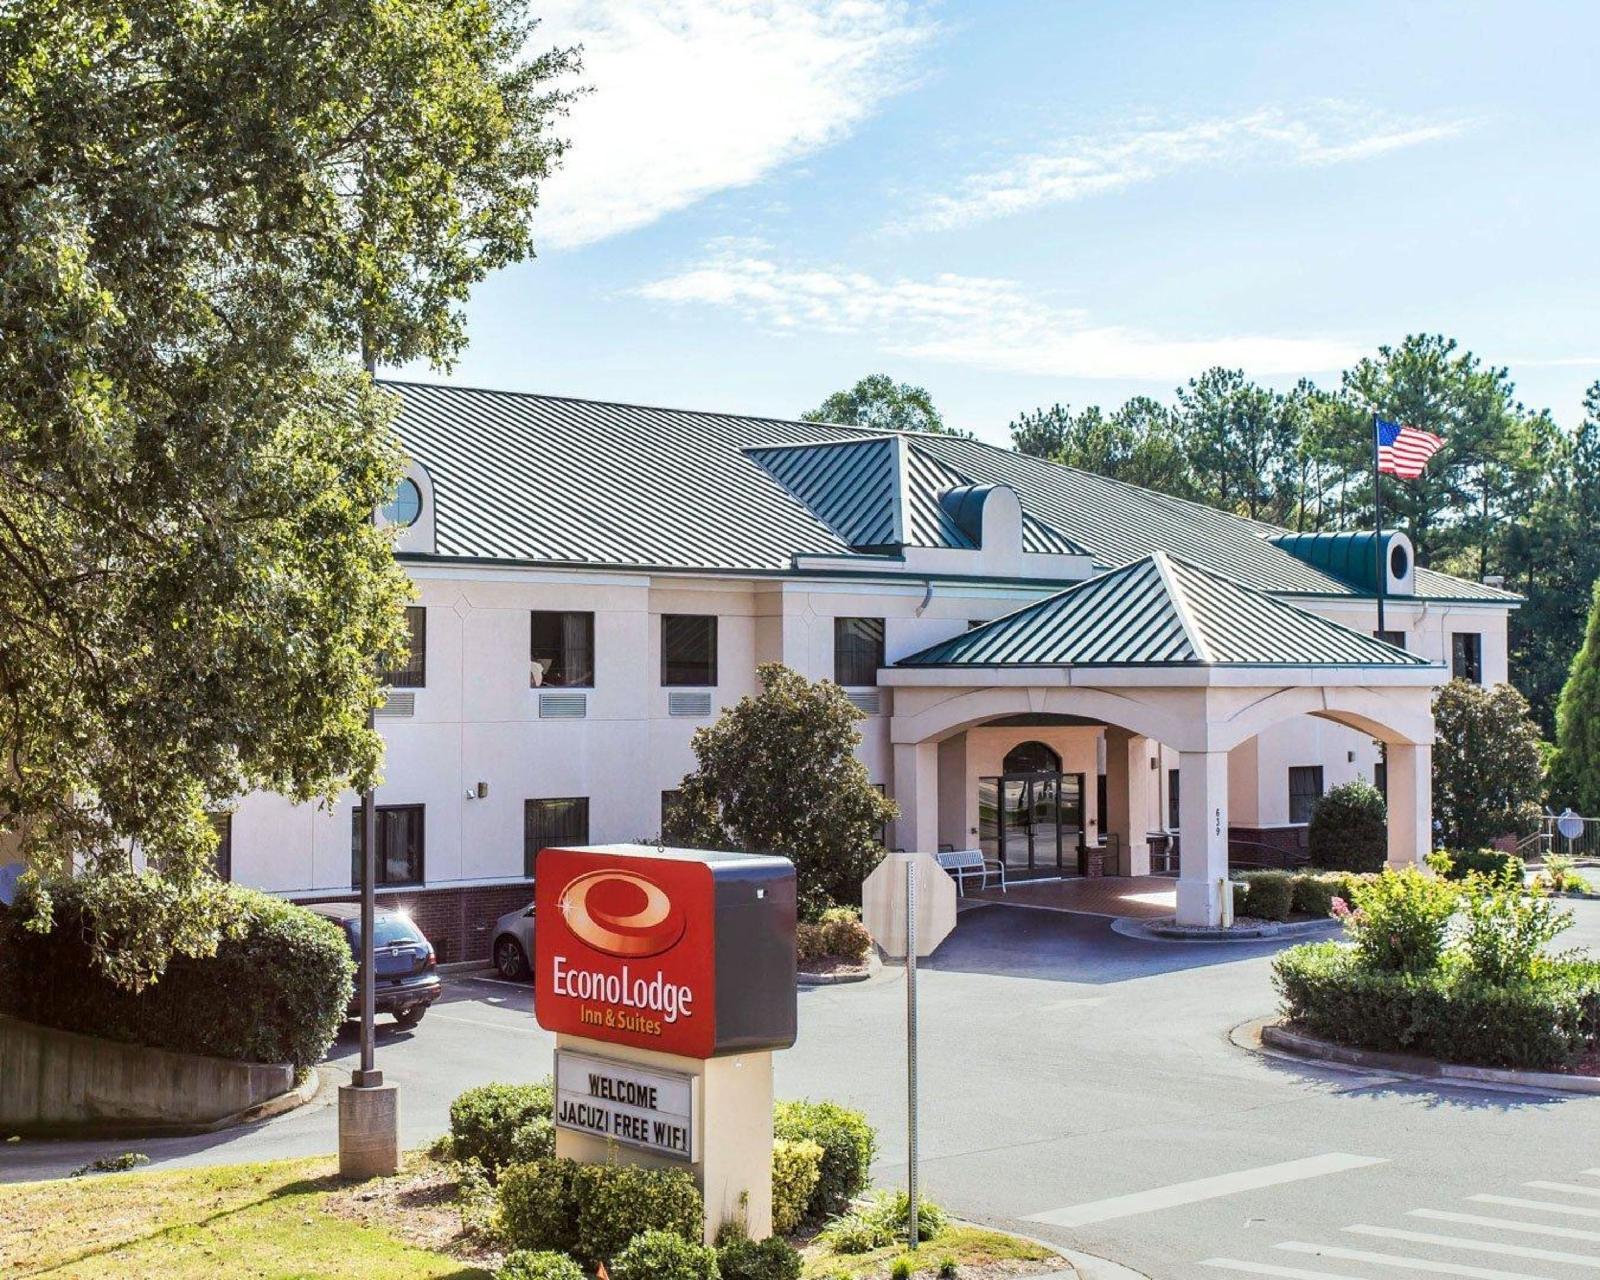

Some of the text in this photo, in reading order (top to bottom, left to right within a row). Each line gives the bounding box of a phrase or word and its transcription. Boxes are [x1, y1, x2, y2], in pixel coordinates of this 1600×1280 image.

[553, 956, 692, 1023] EconoLodge
[580, 1004, 661, 1035] Inn & Suites
[588, 1073, 657, 1110] WELCOME
[559, 1101, 609, 1133] JACUZI
[614, 1113, 648, 1142] FREE
